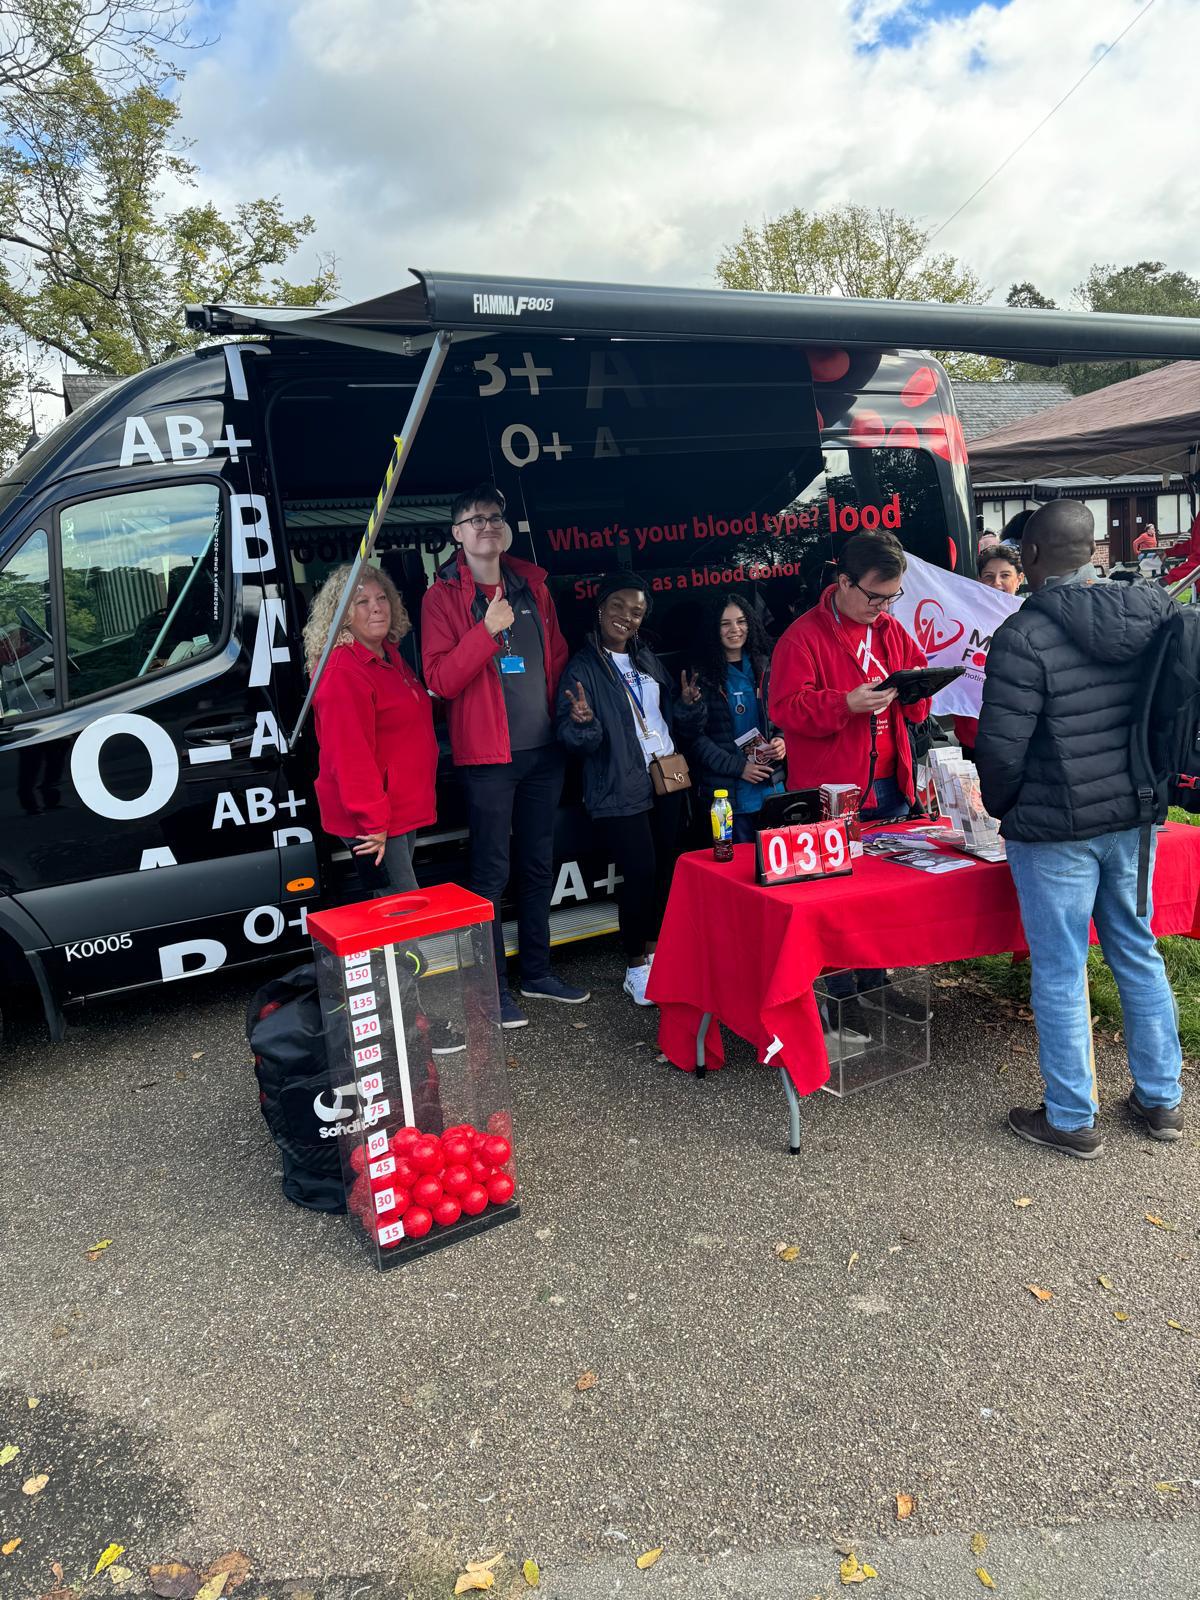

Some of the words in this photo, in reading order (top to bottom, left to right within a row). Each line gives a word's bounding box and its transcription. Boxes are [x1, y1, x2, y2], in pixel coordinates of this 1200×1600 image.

[473, 293, 515, 315] FIAMMA
[119, 415, 252, 466] AB+
[229, 494, 277, 574] B
[547, 523, 631, 552] What's
[634, 523, 688, 550] your
[692, 511, 758, 540] blood
[762, 506, 820, 538] type?
[652, 576, 673, 592] as
[676, 574, 688, 589] a
[691, 564, 745, 588] blood
[748, 561, 801, 580] donor
[70, 713, 232, 820] O-
[211, 786, 306, 830] AB+
[550, 860, 625, 906] A+
[243, 904, 309, 945] O+
[65, 933, 133, 962] K0005
[348, 968, 369, 982] 150
[352, 996, 374, 1010] 135
[355, 1020, 377, 1036] 120
[357, 1046, 379, 1062] 105
[363, 1078, 379, 1092] 90
[370, 1103, 385, 1117] 75
[370, 1136, 385, 1151] 60
[375, 1160, 391, 1174] 45
[376, 1193, 392, 1208] 30
[384, 1226, 400, 1240] 15
